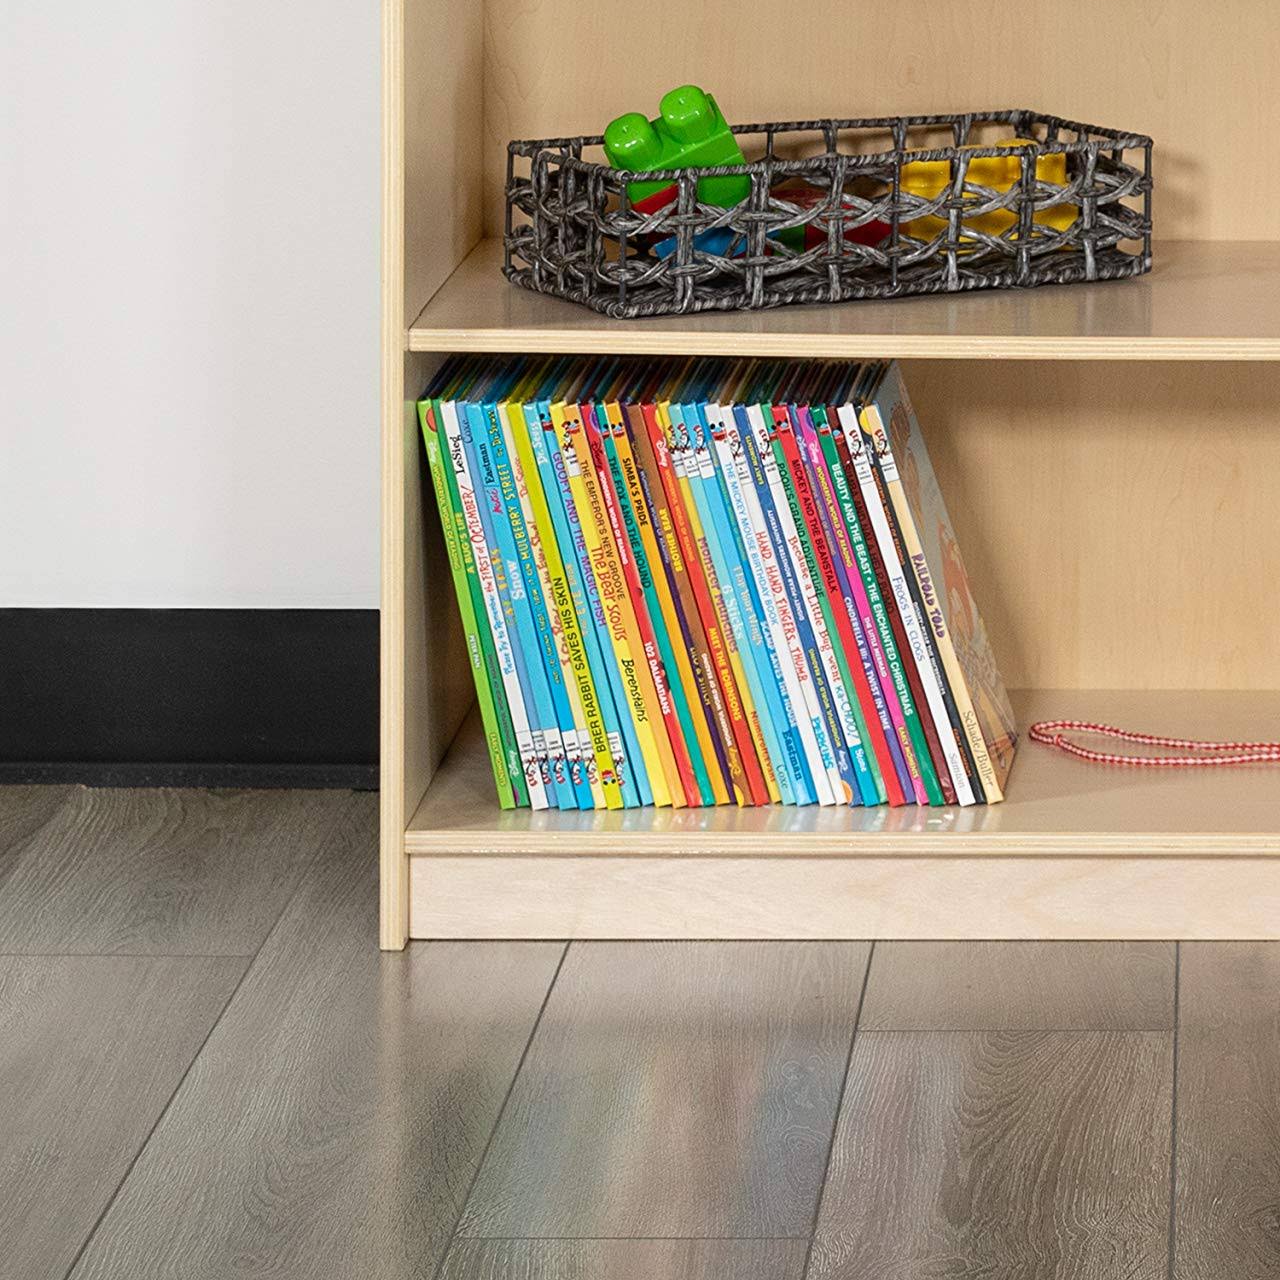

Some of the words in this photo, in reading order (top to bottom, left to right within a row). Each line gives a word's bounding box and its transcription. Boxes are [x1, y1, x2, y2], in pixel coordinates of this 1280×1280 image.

[459, 419, 474, 443] Coxe
[447, 434, 465, 474] LeSieg
[477, 443, 495, 483] Eastman
[606, 456, 620, 476] THE
[652, 436, 672, 467] Disney
[496, 463, 515, 500] STREET
[579, 460, 592, 477] THE
[722, 462, 737, 483] THE
[790, 459, 808, 493] MICKEY
[830, 464, 850, 500] BEAUTY
[613, 480, 627, 500] FOX
[621, 457, 640, 496] SIMBA'S
[633, 499, 648, 526] PRIDE
[729, 484, 746, 514] MICKEY
[454, 512, 465, 529] LIFE
[585, 480, 607, 534] EMPEROR'S
[620, 505, 634, 525] AND
[658, 509, 672, 530] BEAR
[801, 497, 815, 516] AND
[842, 503, 856, 522] AND
[507, 506, 531, 559] MULBERRY
[551, 451, 571, 493] GOOFY
[564, 499, 579, 524] AND
[572, 530, 587, 551] THE
[580, 556, 598, 594] MAGIC
[591, 599, 607, 626] FISH
[626, 527, 640, 547] THE
[739, 516, 757, 552] MOUSE
[776, 462, 795, 500] POOH'S
[788, 502, 806, 536] GRAND
[798, 537, 824, 598] ADVENTURE
[808, 519, 821, 535] THE
[848, 524, 863, 544] THE
[458, 533, 472, 563] BUG'S
[589, 546, 608, 569] The
[600, 537, 614, 558] NEW
[665, 533, 683, 571] BROTHER
[854, 545, 872, 574] BEAST
[505, 559, 524, 599] Snow
[606, 561, 625, 600] GROOVE
[632, 550, 651, 588] HOUND
[750, 554, 771, 598] BIRTHDAY
[814, 539, 838, 592] BEANSTALK
[552, 577, 569, 605] SKIN
[596, 572, 617, 601] Bear
[696, 536, 720, 590] Monster
[713, 594, 738, 653] Munchies
[865, 583, 880, 602] THE
[890, 576, 911, 610] FROGS
[909, 553, 938, 605] RAILROAD
[927, 608, 948, 638] TOAD
[560, 609, 575, 628] HIS
[724, 598, 746, 639] Sticks
[764, 599, 778, 625] BOOK
[843, 596, 866, 645] CINDERELLA
[903, 615, 916, 626] IN
[707, 627, 720, 648] MEET
[872, 605, 897, 658] ENCHANTED
[908, 630, 926, 662] CLOGS
[566, 632, 585, 670] SAVES
[643, 640, 655, 657] 102
[714, 651, 725, 666] THE
[577, 675, 598, 717] RABBIT
[620, 659, 648, 721] Berenstains
[648, 659, 671, 714] DALMATIANS
[719, 669, 740, 720] ROBINSONS
[865, 670, 881, 696] TWIST
[889, 662, 913, 715] CHRISTMAS
[874, 698, 884, 708] IN
[588, 720, 606, 751] BRER
[877, 710, 891, 730] TIME
[781, 731, 804, 780] Eastman
[809, 716, 834, 769] PERKINS
[960, 710, 997, 786] Schade/Buller
[774, 763, 790, 788] Coxe
[946, 752, 966, 787] Samton
